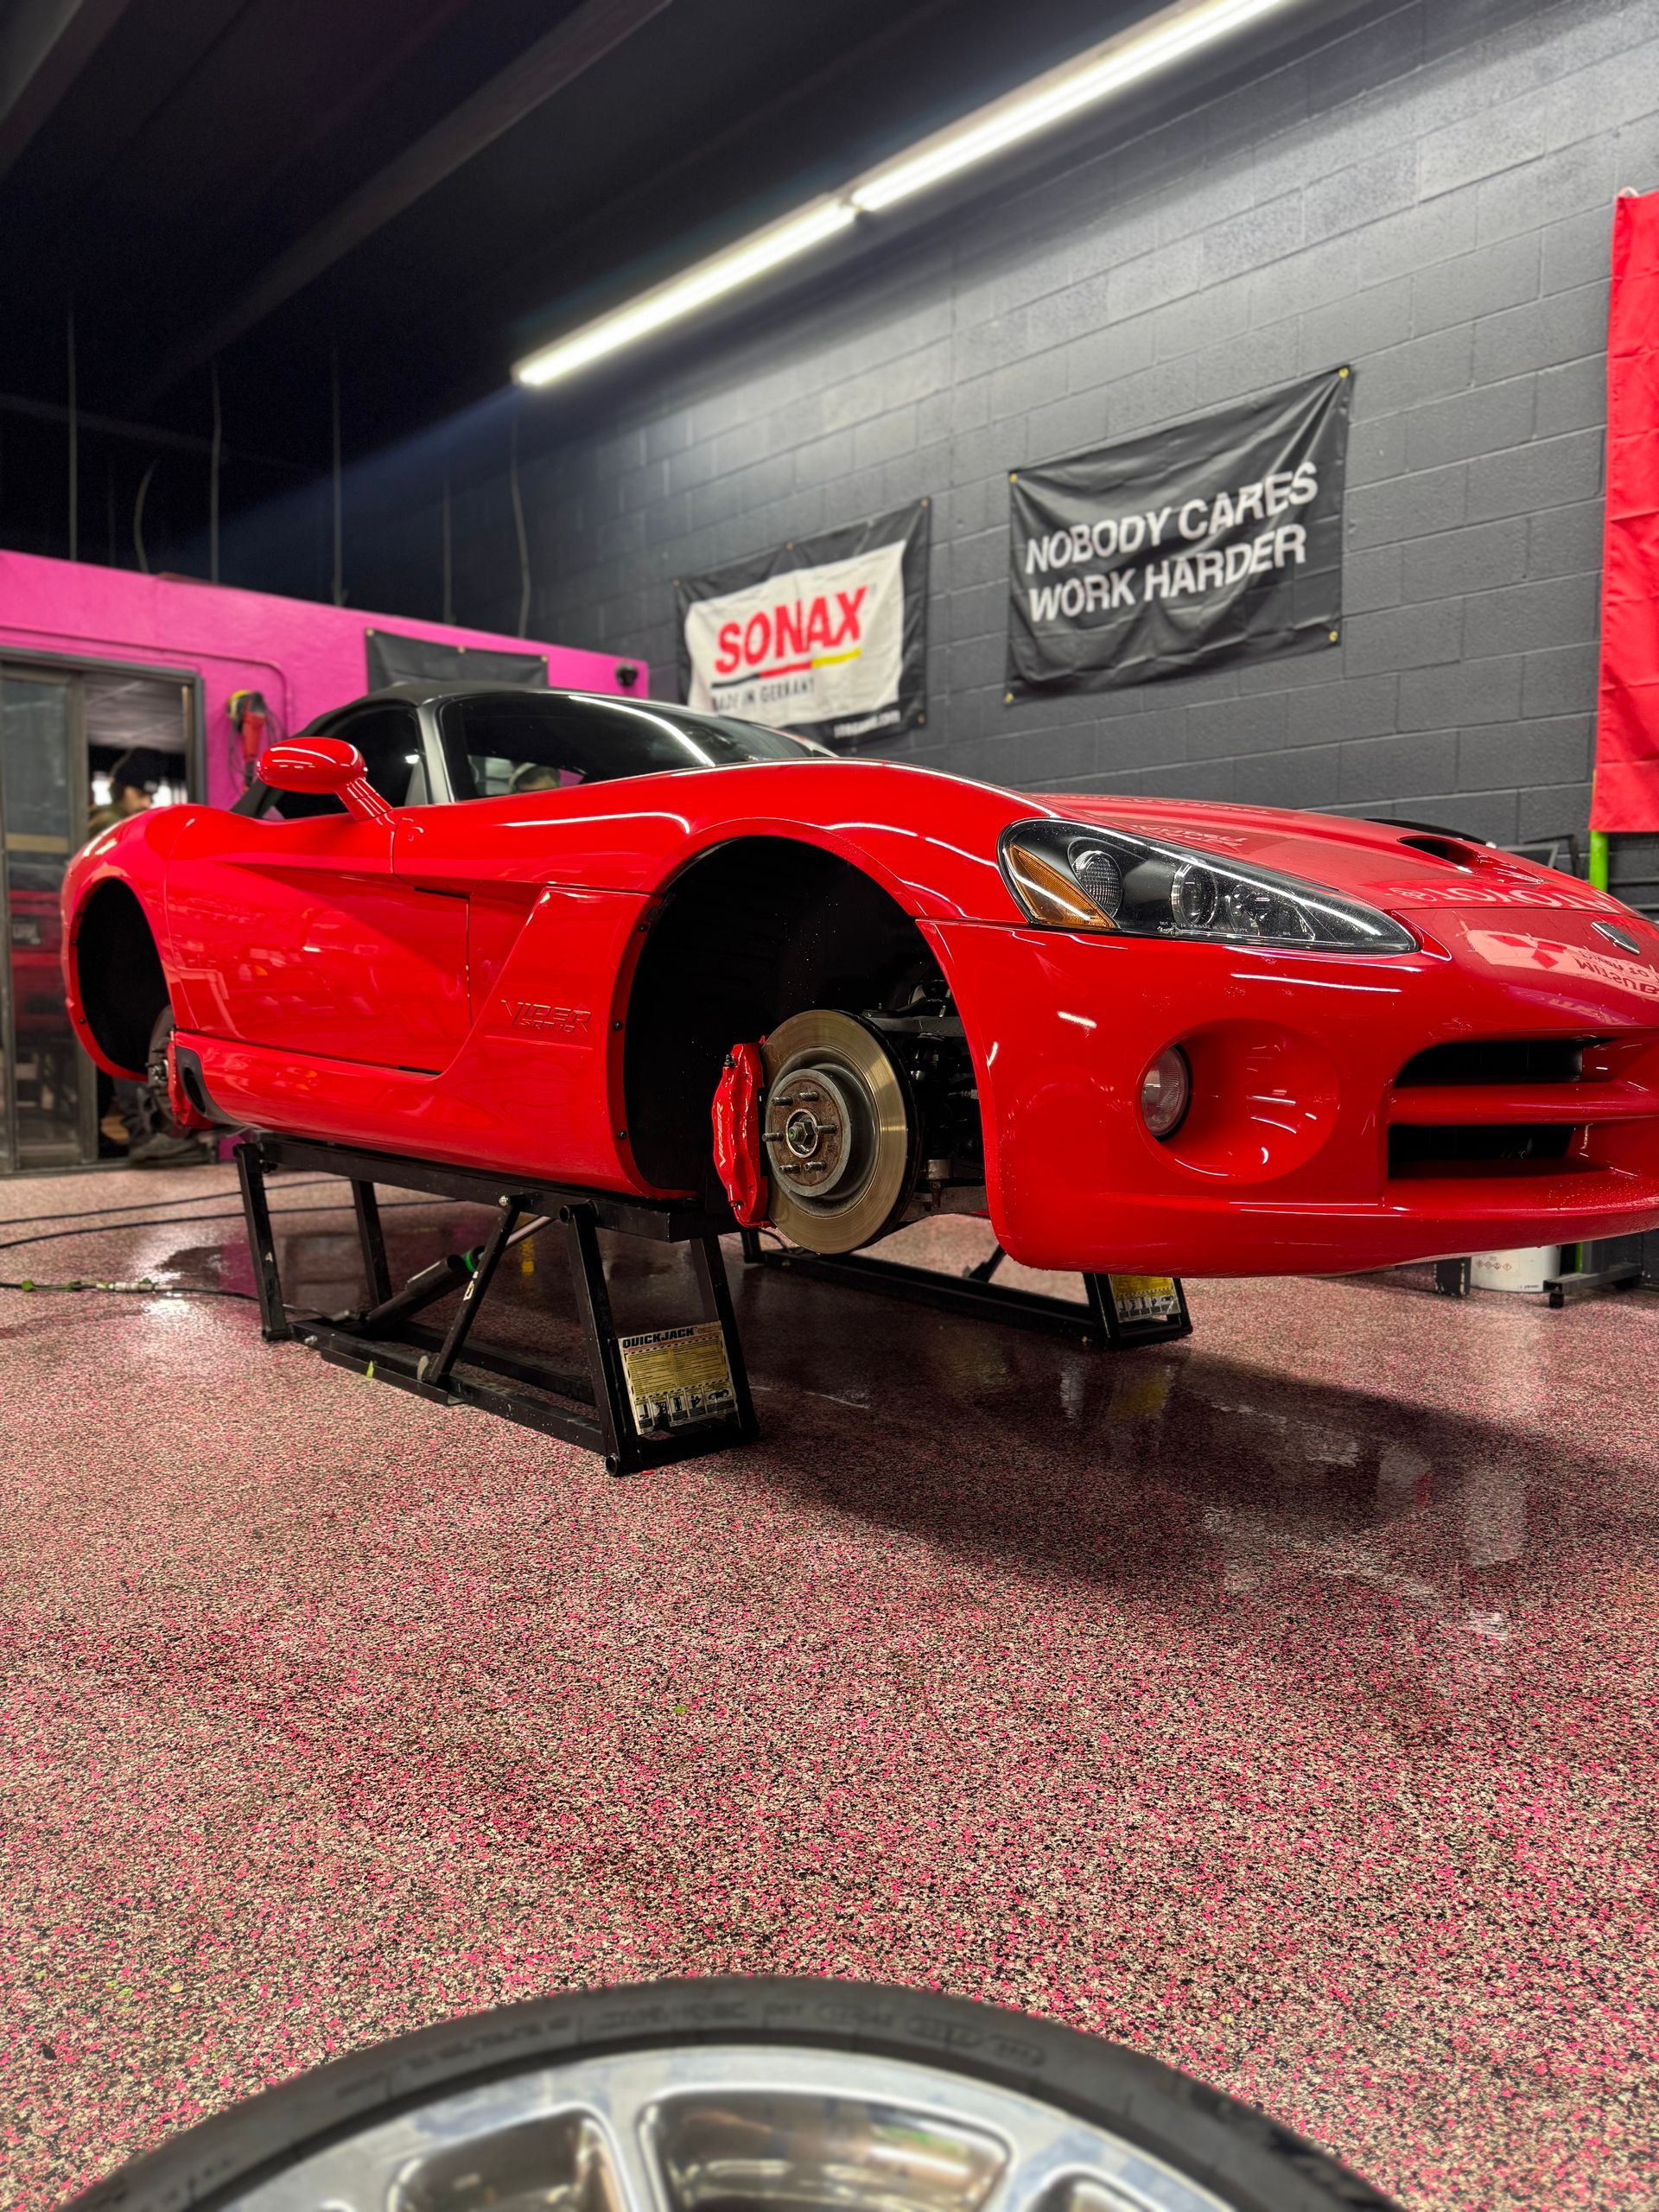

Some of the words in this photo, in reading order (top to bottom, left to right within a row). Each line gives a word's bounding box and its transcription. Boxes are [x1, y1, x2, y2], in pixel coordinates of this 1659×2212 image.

[1025, 505, 1172, 575] NOBODY
[1178, 461, 1318, 540] CARES
[1027, 568, 1136, 622] WORK
[1144, 523, 1306, 601] HARDER
[714, 584, 868, 675] SONAX
[501, 999, 592, 1033] VIPER
[716, 1101, 727, 1168] VIPER
[622, 1326, 695, 1349] QUICKJACK
